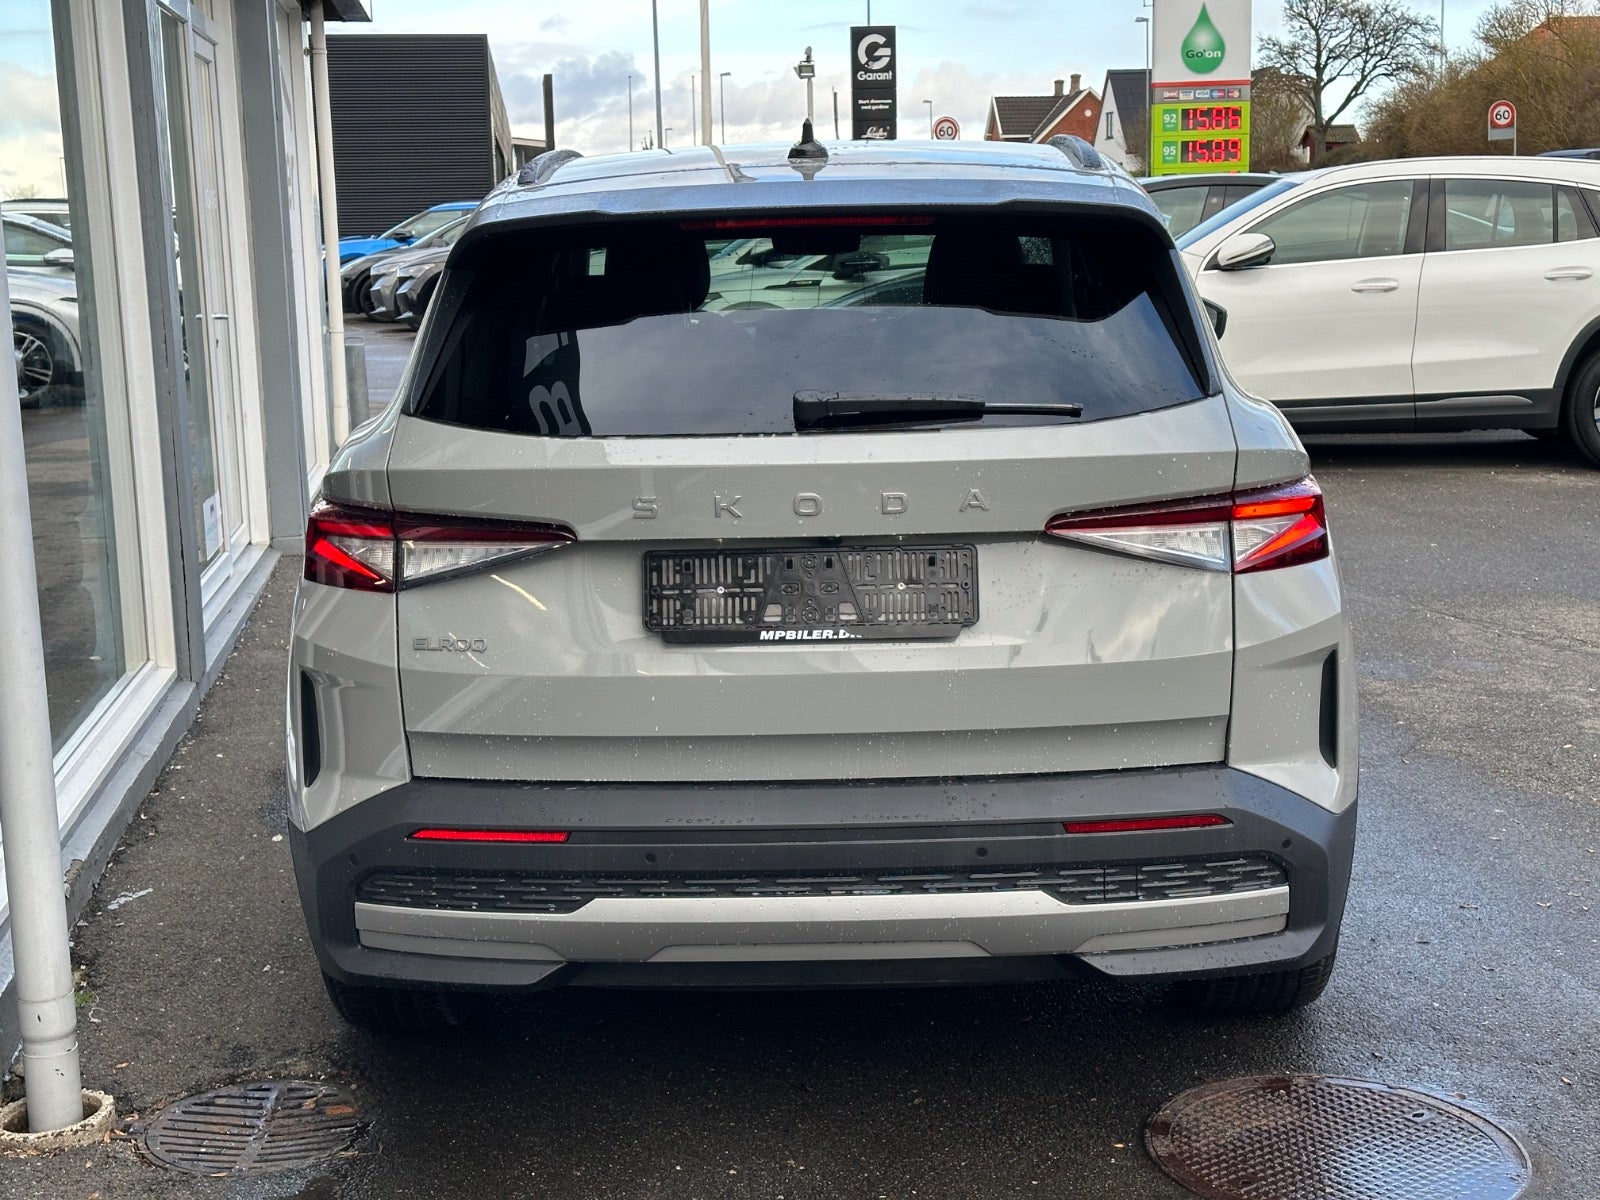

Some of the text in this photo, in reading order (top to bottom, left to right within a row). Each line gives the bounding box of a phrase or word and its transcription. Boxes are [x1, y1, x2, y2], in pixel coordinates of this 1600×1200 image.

[1185, 49, 1222, 59] Go'on
[857, 70, 893, 81] Garant
[1163, 106, 1241, 131] 92 15.86
[1495, 110, 1511, 121] 60
[939, 126, 954, 137] 60
[1163, 138, 1241, 163] 95 15.89
[632, 489, 989, 519] SKODA
[760, 629, 863, 640] MPBILER.D
